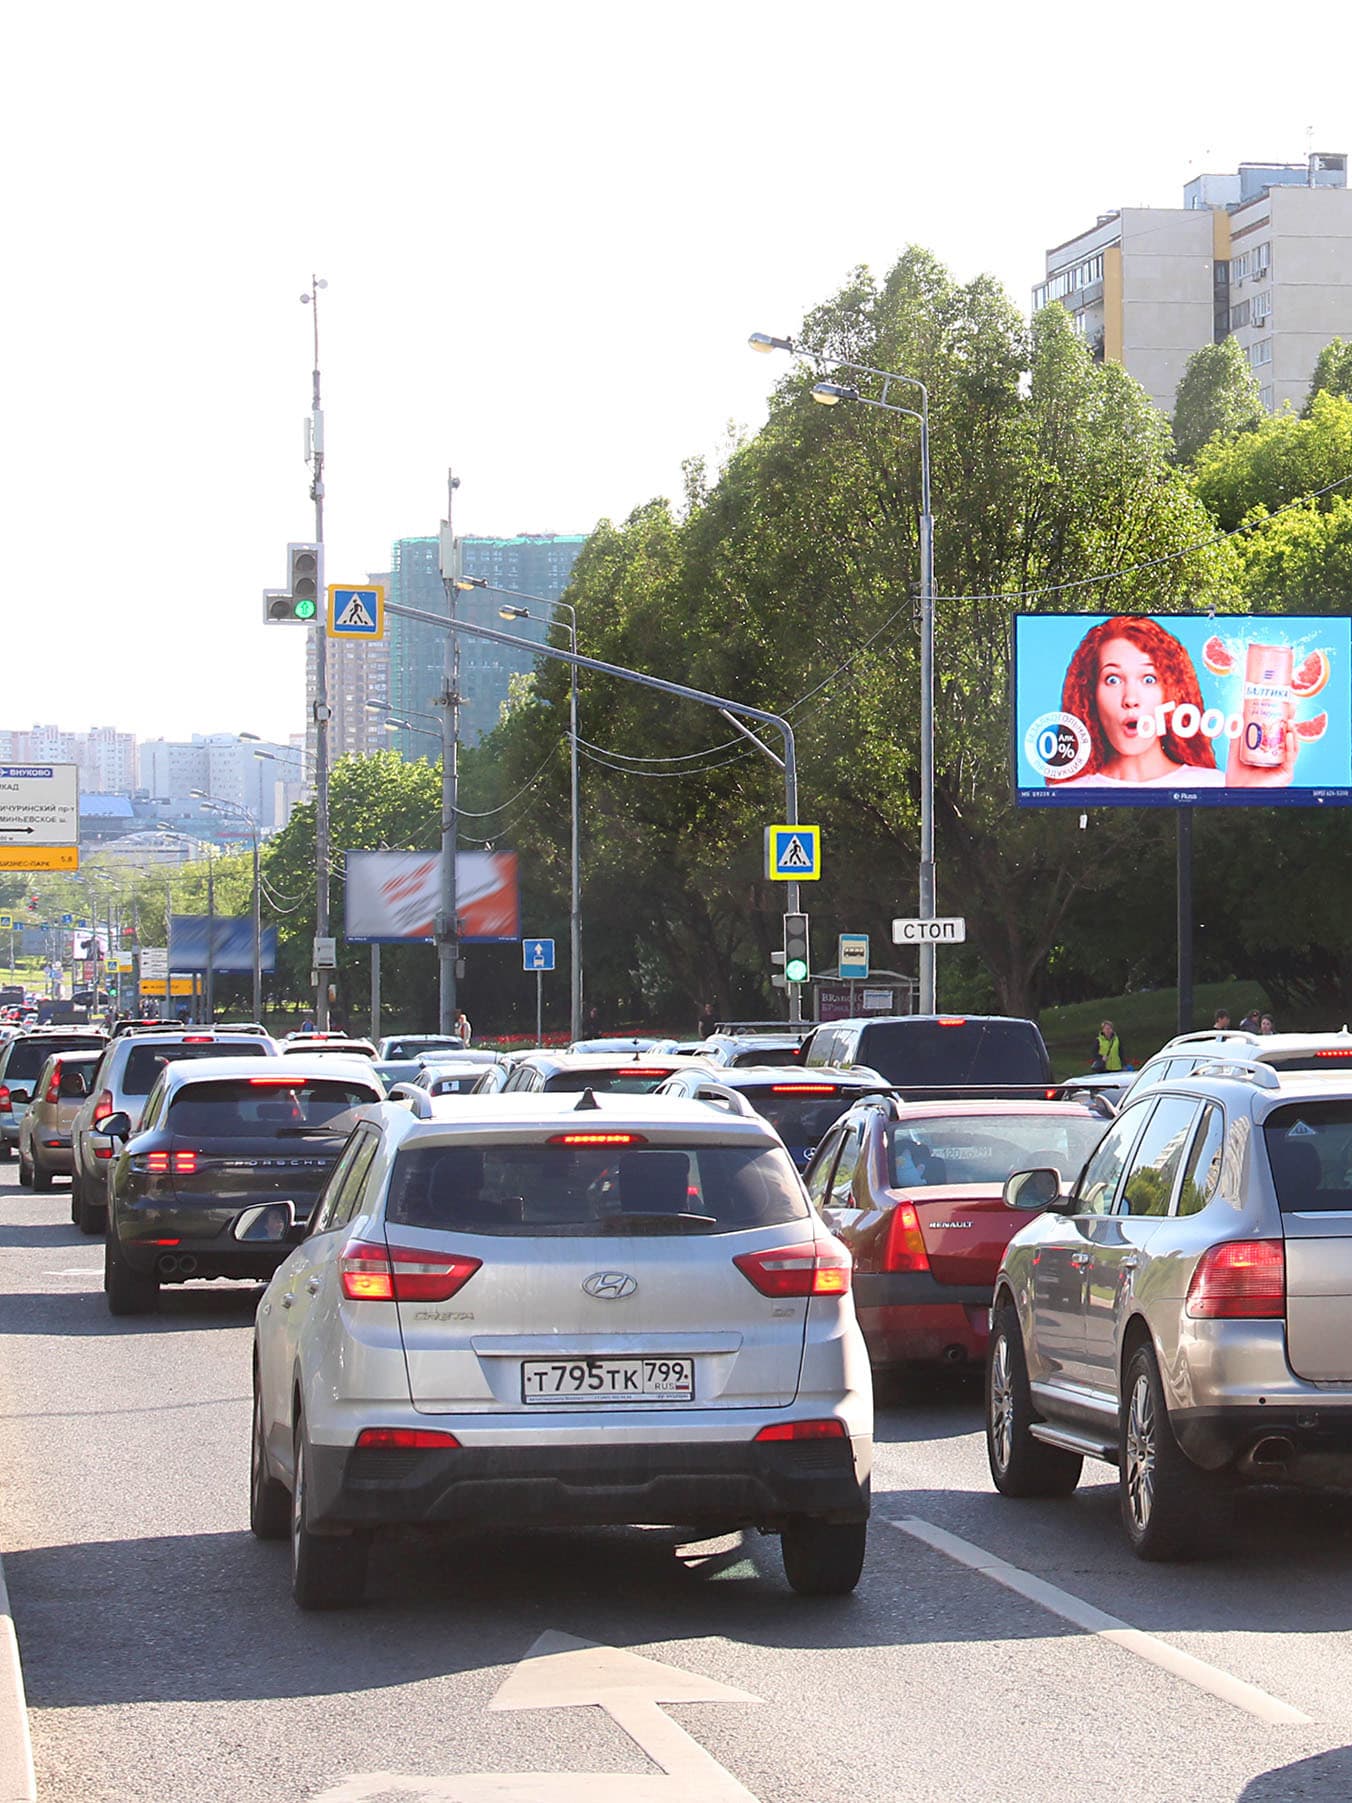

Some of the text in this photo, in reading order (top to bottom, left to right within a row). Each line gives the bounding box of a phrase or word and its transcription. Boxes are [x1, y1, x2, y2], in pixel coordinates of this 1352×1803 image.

[9, 769, 51, 777] ВНУКОВО
[903, 923, 955, 939] СТОП
[929, 1220, 974, 1229] RENAULT
[645, 1362, 685, 1382] 799
[654, 1382, 675, 1390] RUS
